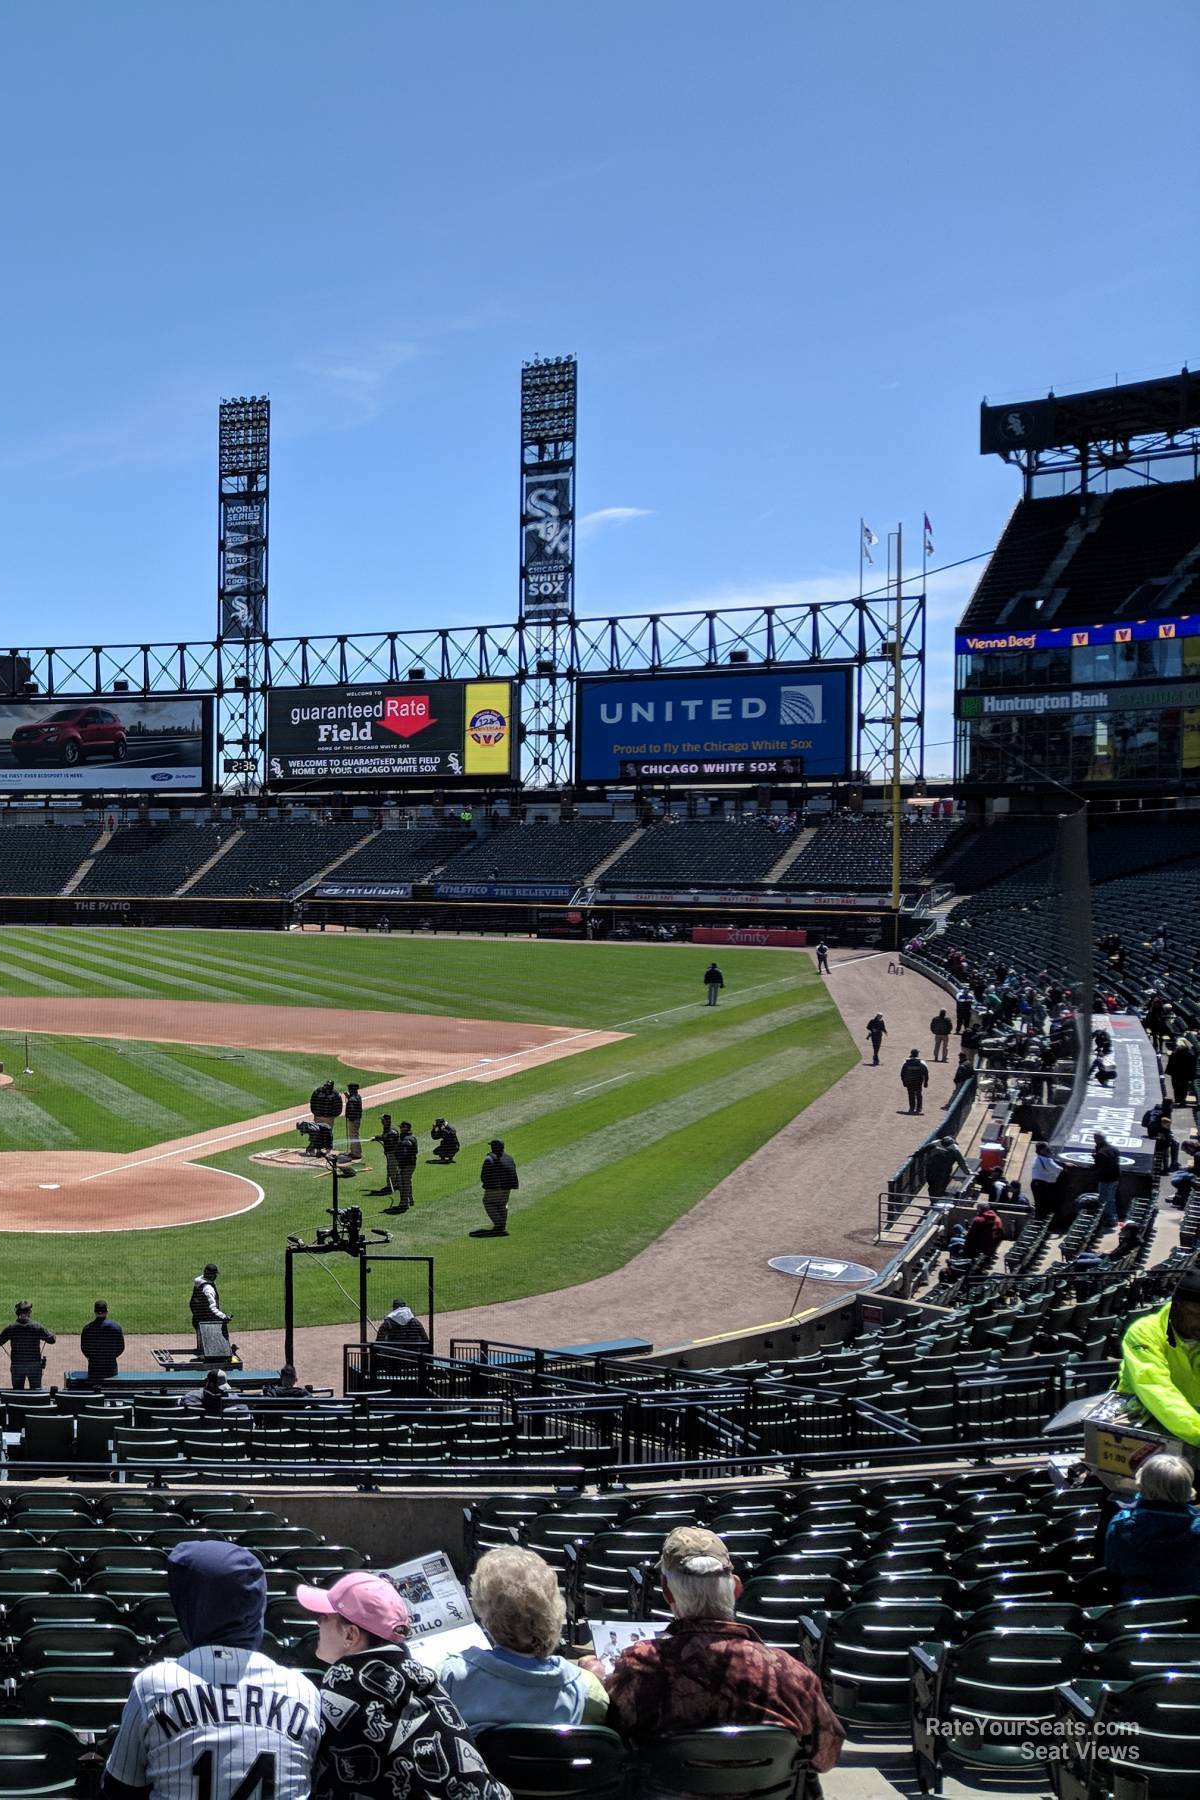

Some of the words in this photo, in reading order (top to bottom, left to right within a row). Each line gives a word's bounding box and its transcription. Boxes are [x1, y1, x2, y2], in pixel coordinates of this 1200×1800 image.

[226, 504, 260, 514] WORLD
[226, 512, 260, 522] SERIES
[528, 564, 565, 574] CHICAGO
[528, 572, 565, 582] WHITE
[528, 581, 565, 596] SOX
[966, 638, 1007, 650] Vienna
[1008, 634, 1037, 649] Beef
[984, 694, 1070, 714] Huntington
[1072, 692, 1108, 708] Bank
[291, 700, 383, 725] guaranteed
[387, 700, 427, 717] Rate
[600, 698, 768, 724] UNITED
[318, 722, 373, 742] Field
[612, 744, 647, 755] Proud
[649, 744, 660, 754] to
[664, 742, 678, 756] fly
[682, 742, 700, 752] the
[703, 741, 749, 754] Chicago
[751, 740, 788, 750] White
[790, 739, 812, 750] Sox
[232, 760, 256, 771] 2:36
[288, 759, 328, 768] WELCOME
[342, 758, 396, 766] GUARANTEED
[397, 757, 417, 765] RATE
[418, 756, 441, 764] FIELD
[292, 767, 316, 775] HOME
[330, 766, 352, 774] YOUR
[354, 766, 390, 774] CHICAGO
[392, 765, 418, 774] WHITE
[420, 764, 437, 772] SOX
[640, 764, 699, 774] CHICAGO
[703, 763, 744, 774] WHITE
[749, 762, 776, 772] SOX
[346, 886, 405, 895] HYUNDAI
[437, 884, 488, 894] ATHLETICO
[494, 888, 513, 896] THE
[514, 888, 570, 897] RELIEVERS
[74, 902, 96, 910] THE
[98, 902, 131, 910] PATIO
[867, 916, 881, 924] 335
[726, 930, 770, 944] xfinity
[150, 1682, 310, 1742] KONERKO
